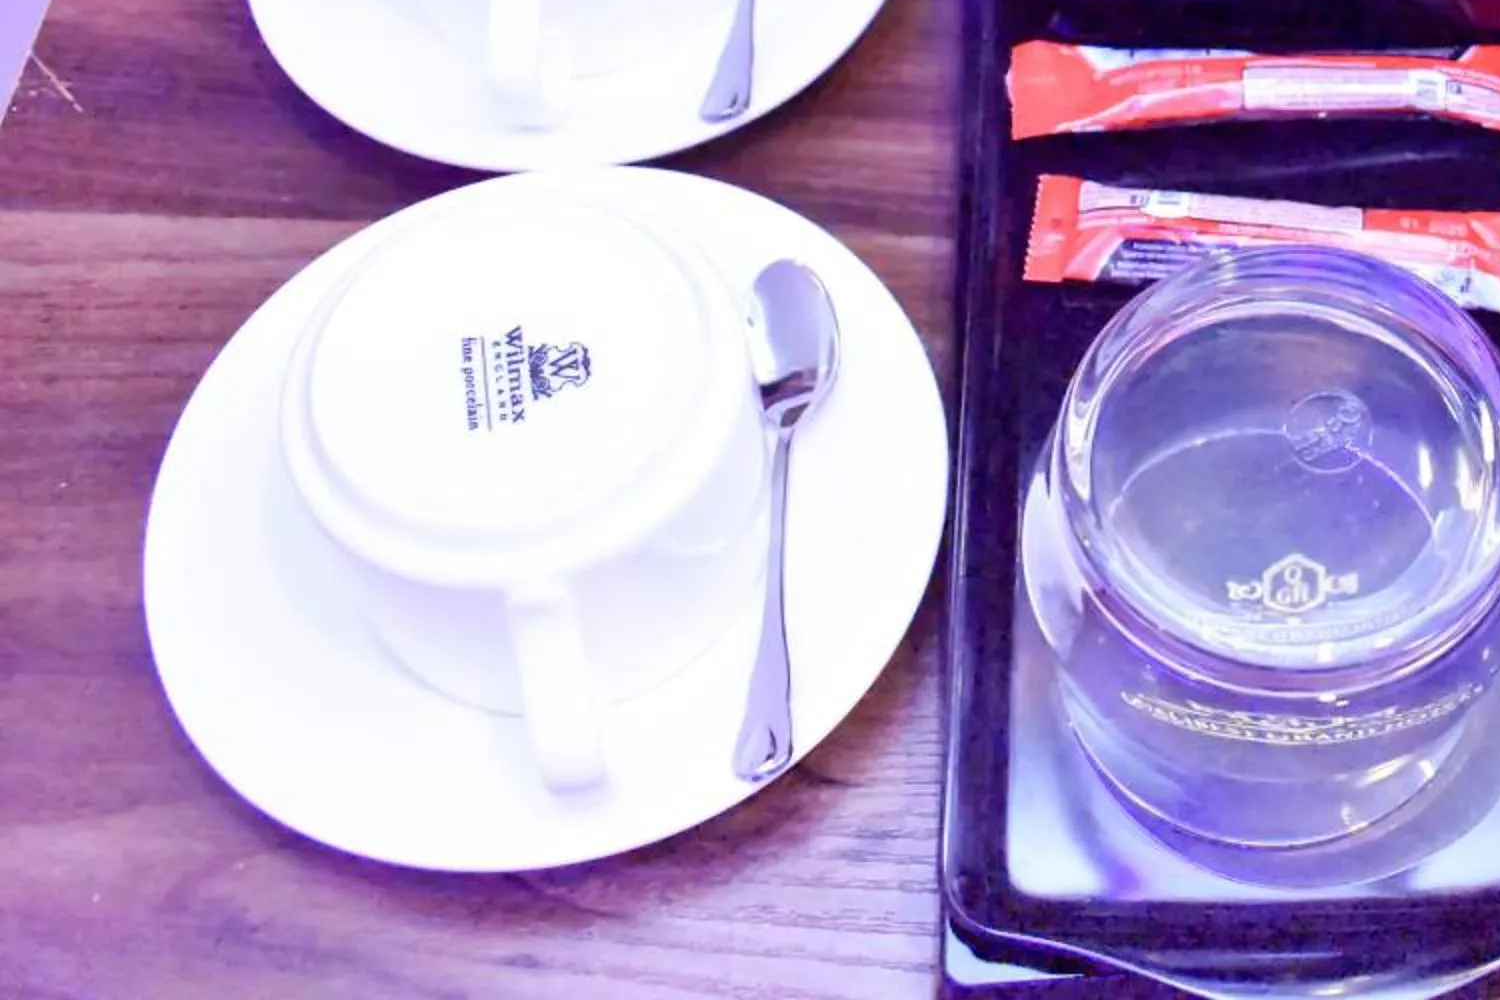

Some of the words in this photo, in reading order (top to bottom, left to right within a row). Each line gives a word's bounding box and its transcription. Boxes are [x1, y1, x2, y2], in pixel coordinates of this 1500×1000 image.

[461, 337, 479, 363] fine
[505, 325, 525, 423] Wilmax
[461, 366, 484, 431] porcelain
